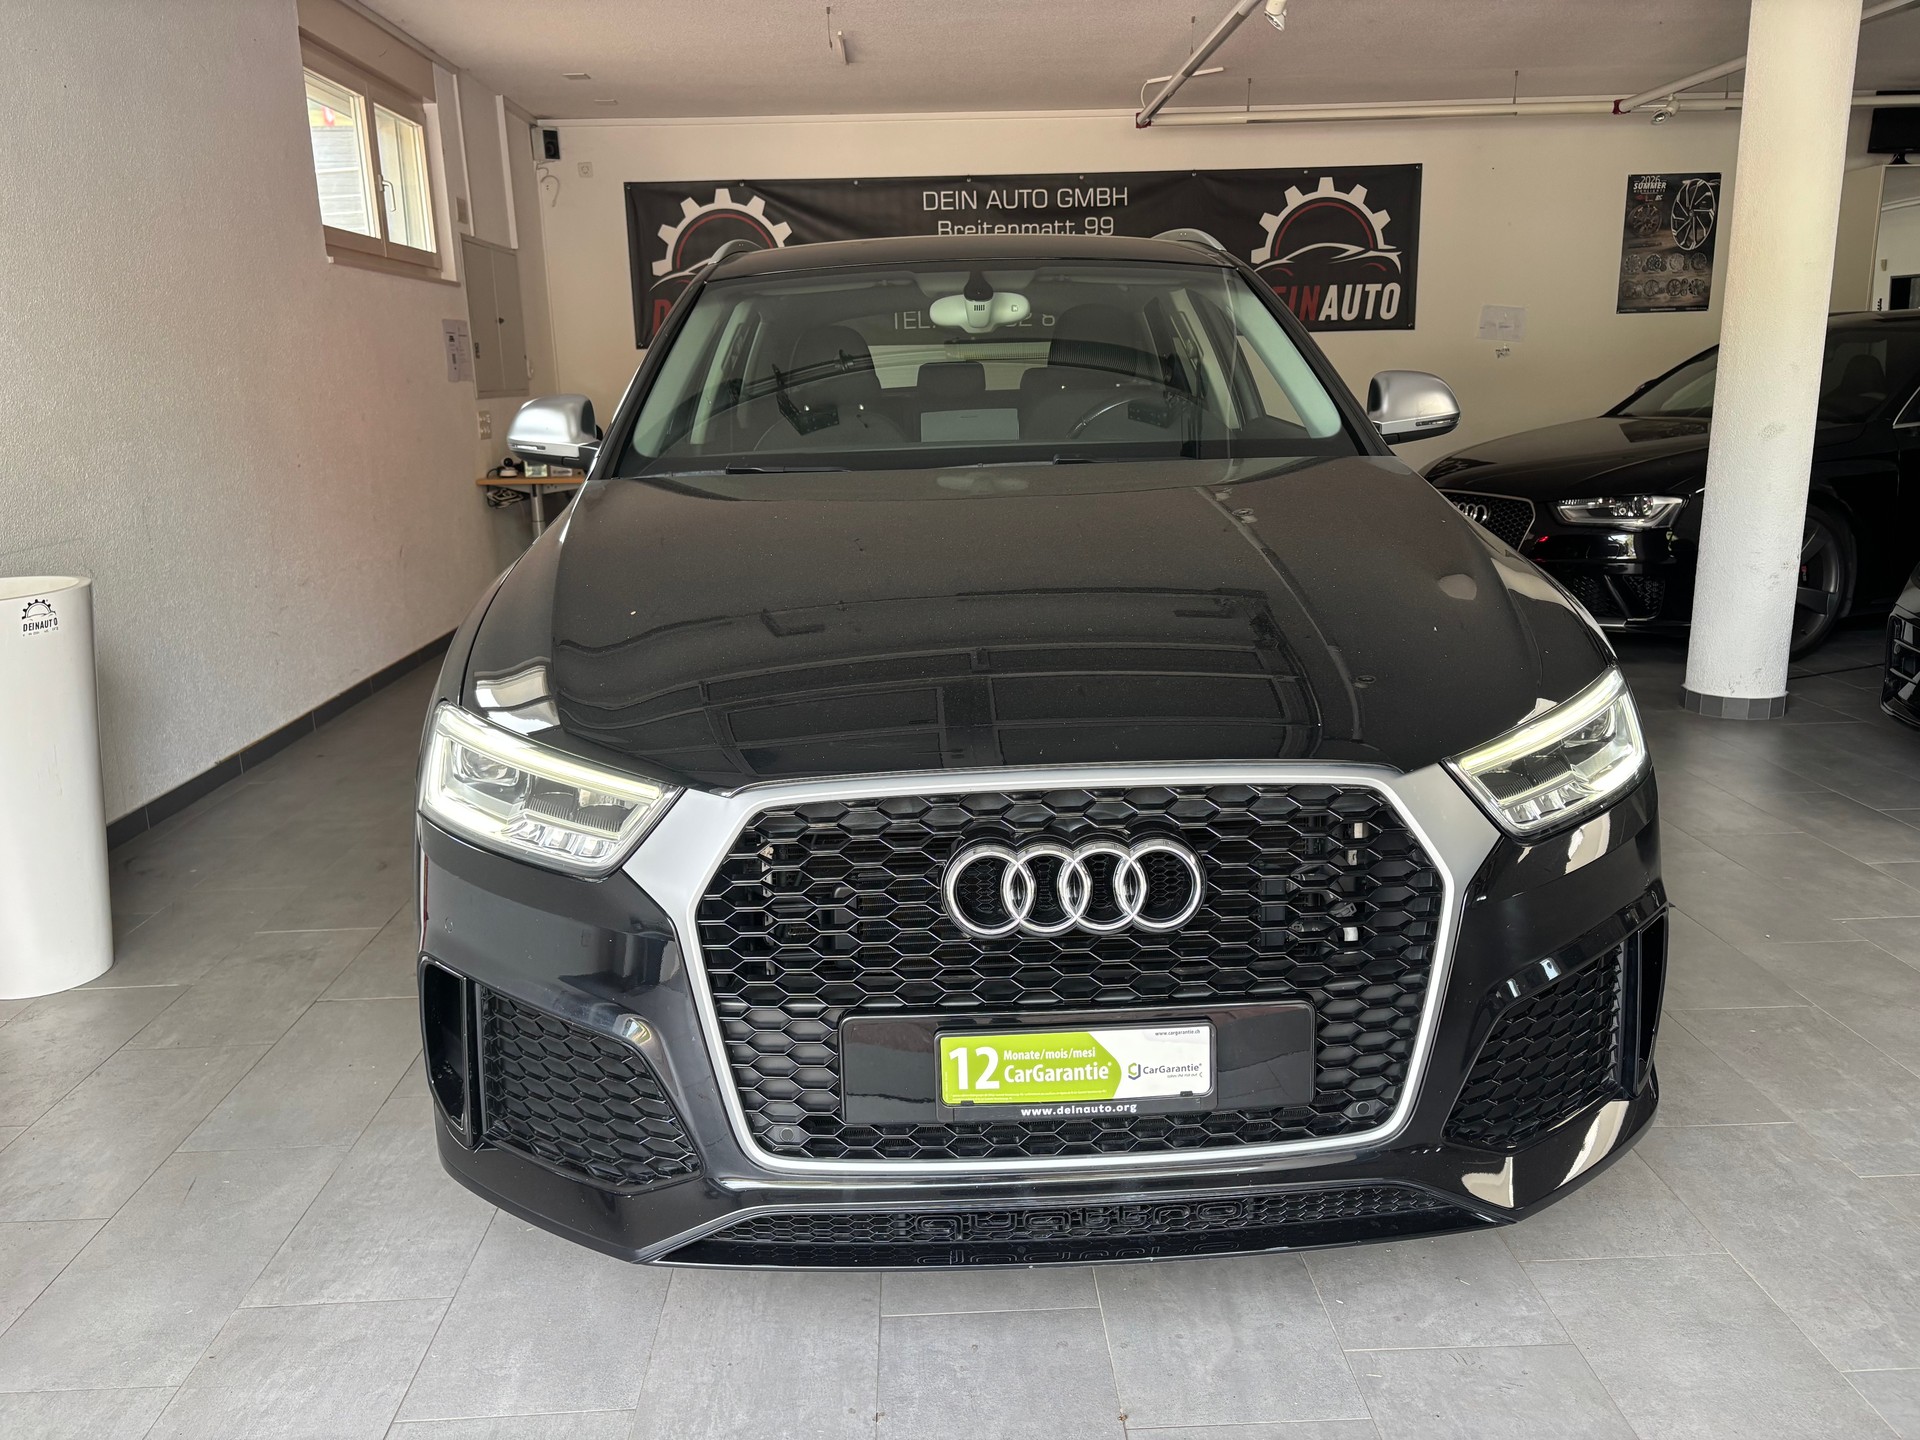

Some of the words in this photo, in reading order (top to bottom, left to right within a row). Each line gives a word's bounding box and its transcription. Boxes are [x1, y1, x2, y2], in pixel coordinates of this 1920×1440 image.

[923, 191, 977, 211] DEIN
[986, 189, 1048, 209] AUTO
[1056, 187, 1128, 208] GMBH
[938, 219, 1075, 236] Breitenmatt
[1084, 216, 1114, 236] 99
[1273, 282, 1401, 321] INAUTO
[23, 617, 58, 632] DEINAUTO
[1155, 1028, 1201, 1037] www.cargarantie.ch
[1003, 1047, 1096, 1060] Monate/mois/mesi
[949, 1046, 1000, 1090] 12
[1021, 1103, 1138, 1117] www.deinauto.org
